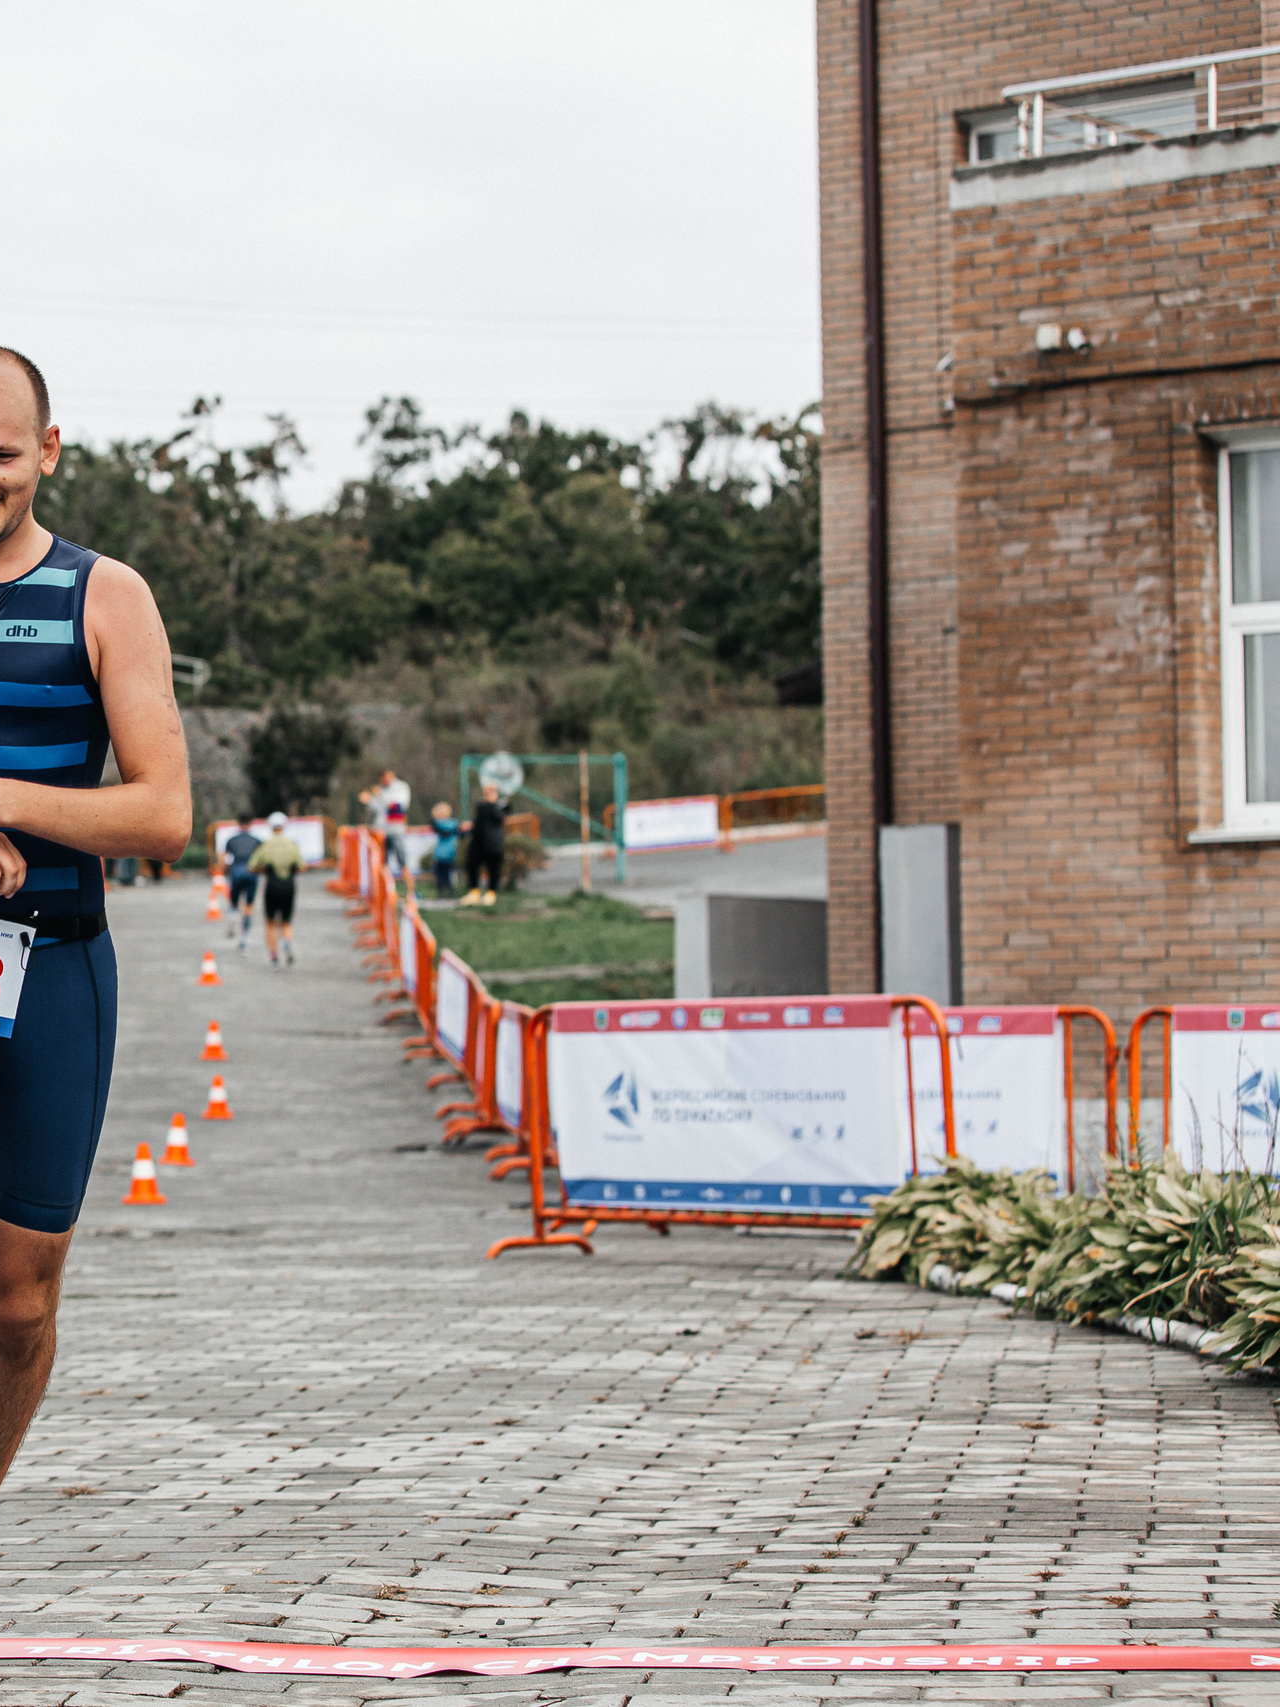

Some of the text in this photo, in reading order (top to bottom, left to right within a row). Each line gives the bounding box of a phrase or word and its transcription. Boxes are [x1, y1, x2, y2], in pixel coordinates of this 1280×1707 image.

[5, 624, 38, 638] dhb
[24, 1644, 436, 1672] TRIATHLON
[472, 1651, 1100, 1670] CHAMPIONSHIP
